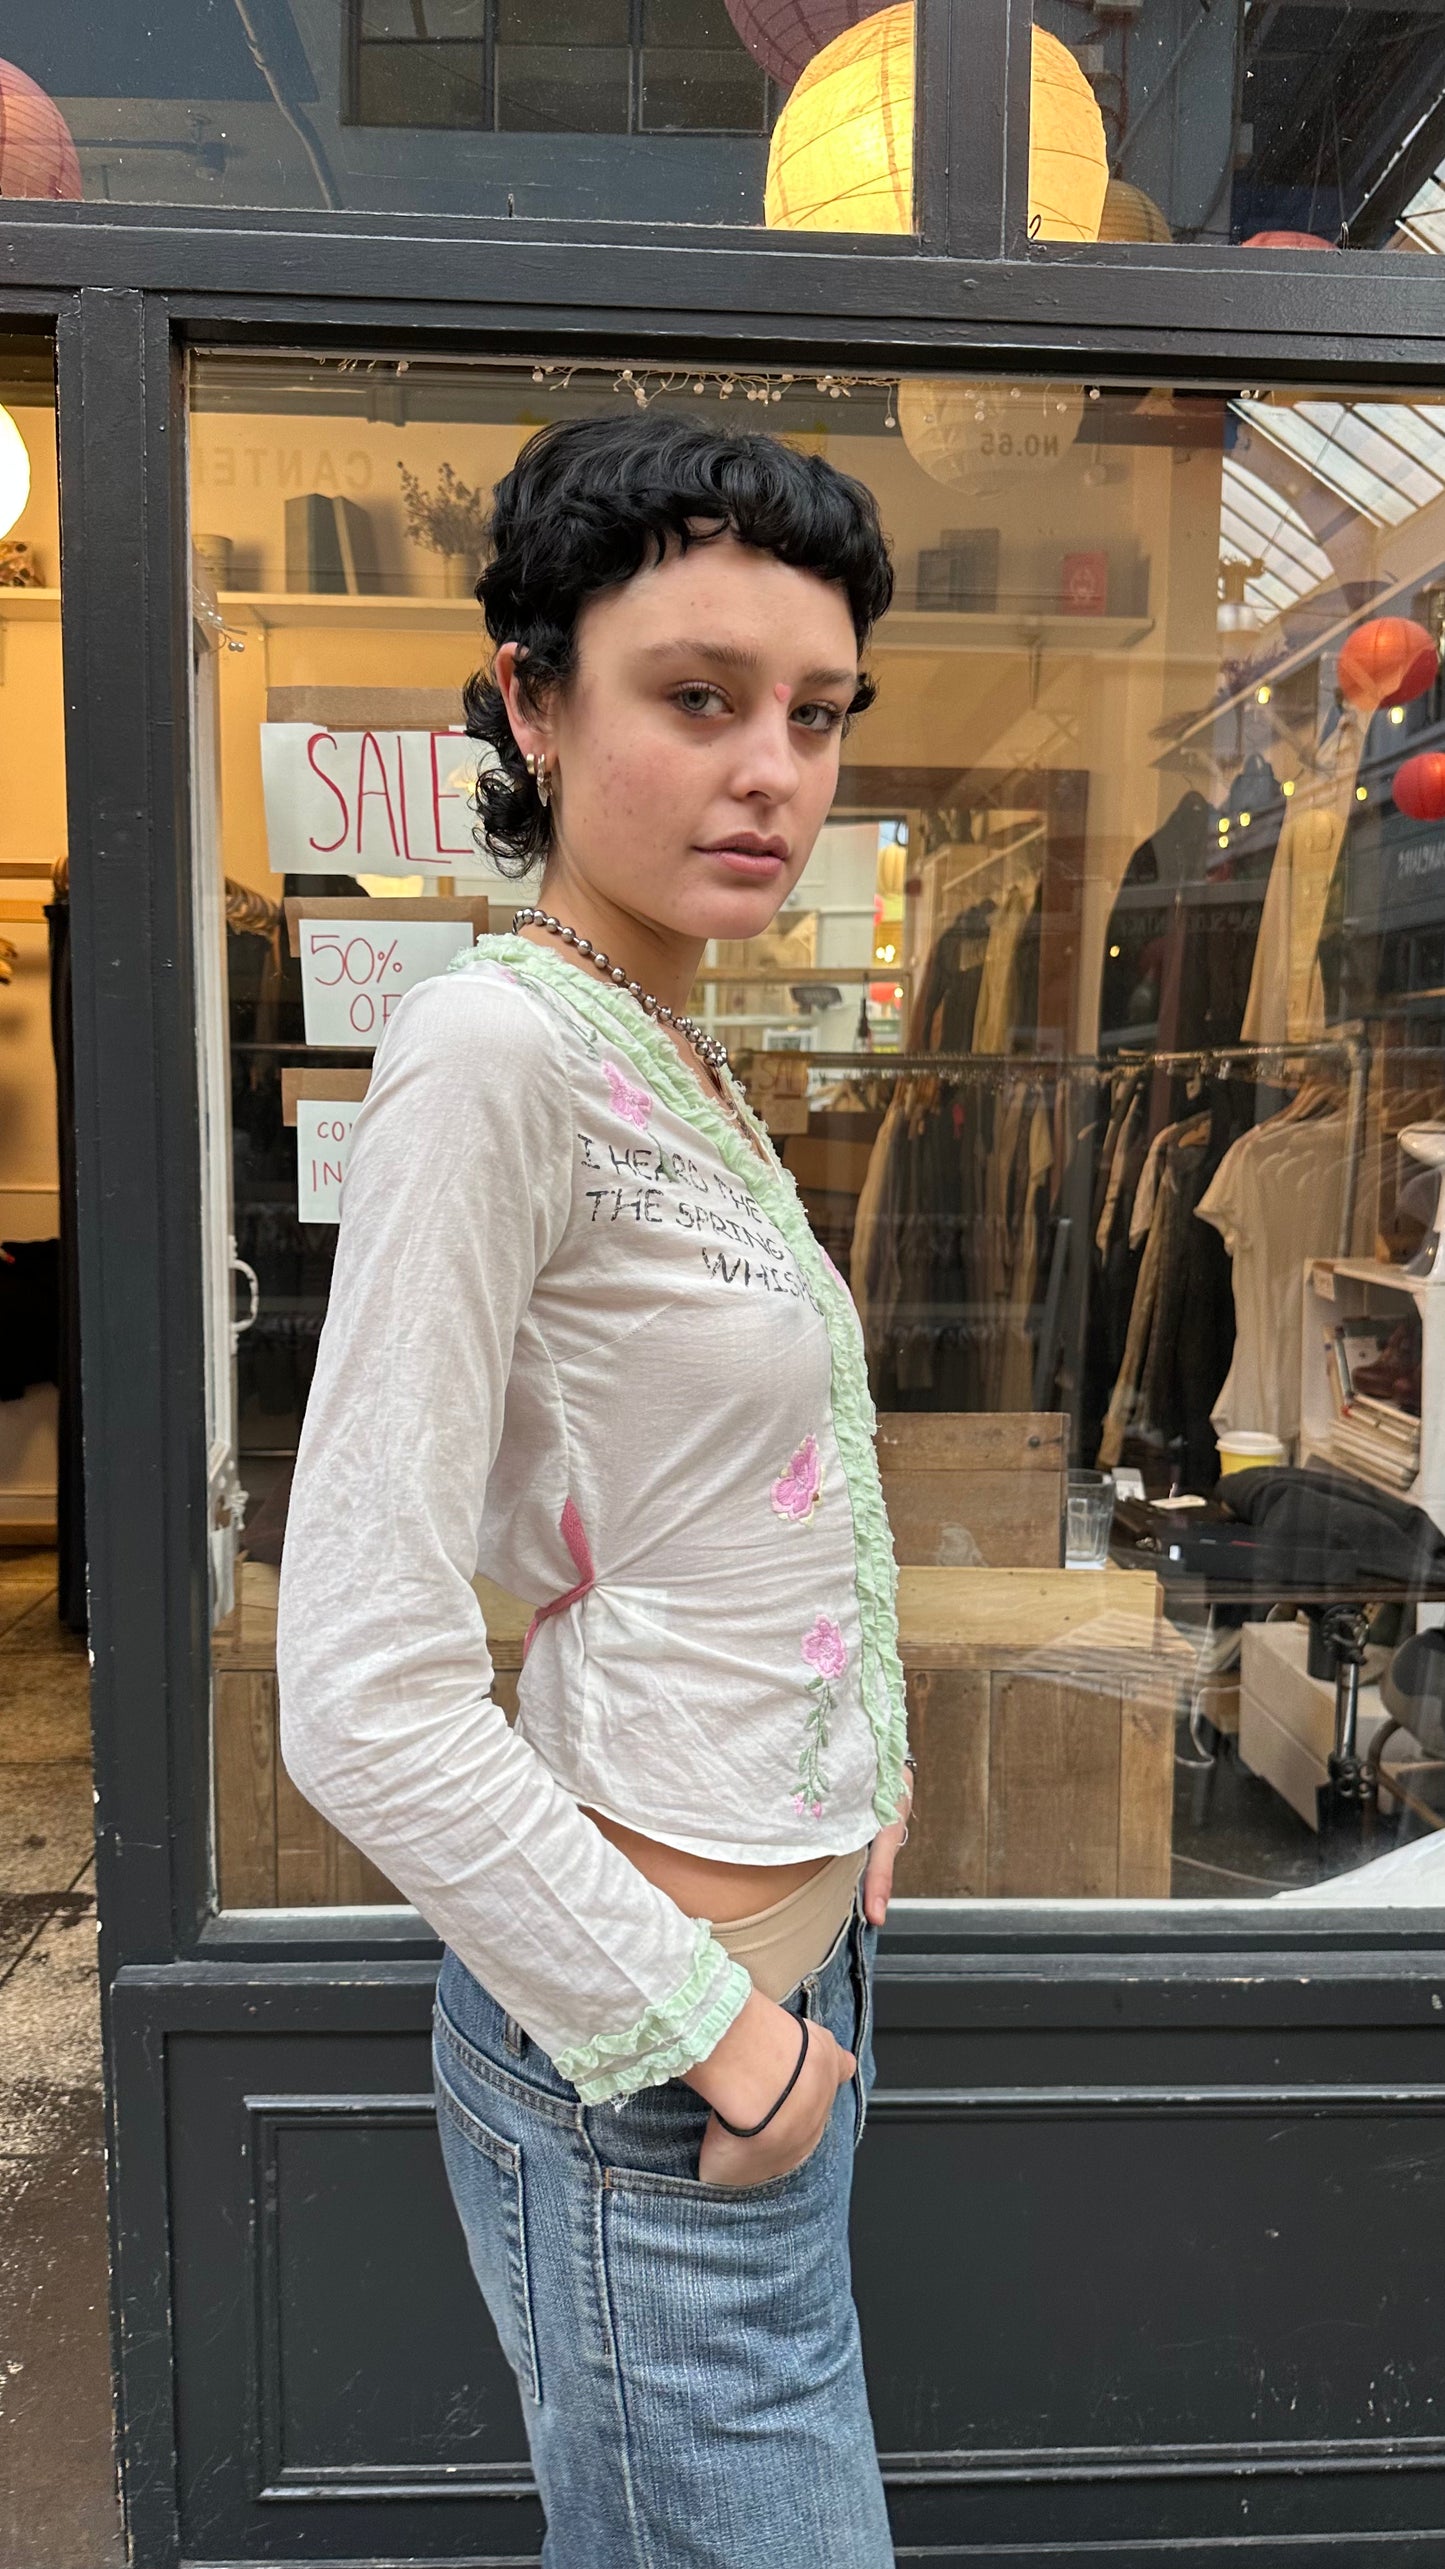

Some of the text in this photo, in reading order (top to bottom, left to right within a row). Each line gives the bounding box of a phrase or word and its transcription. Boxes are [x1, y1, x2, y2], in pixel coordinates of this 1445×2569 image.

[307, 731, 475, 864] SALE
[310, 935, 402, 986] 50%
[317, 1121, 353, 1142] CO
[312, 1159, 343, 1192] IN
[577, 1133, 601, 1170] I
[713, 1174, 763, 1224] THE
[586, 1188, 785, 1261] THE SPRING
